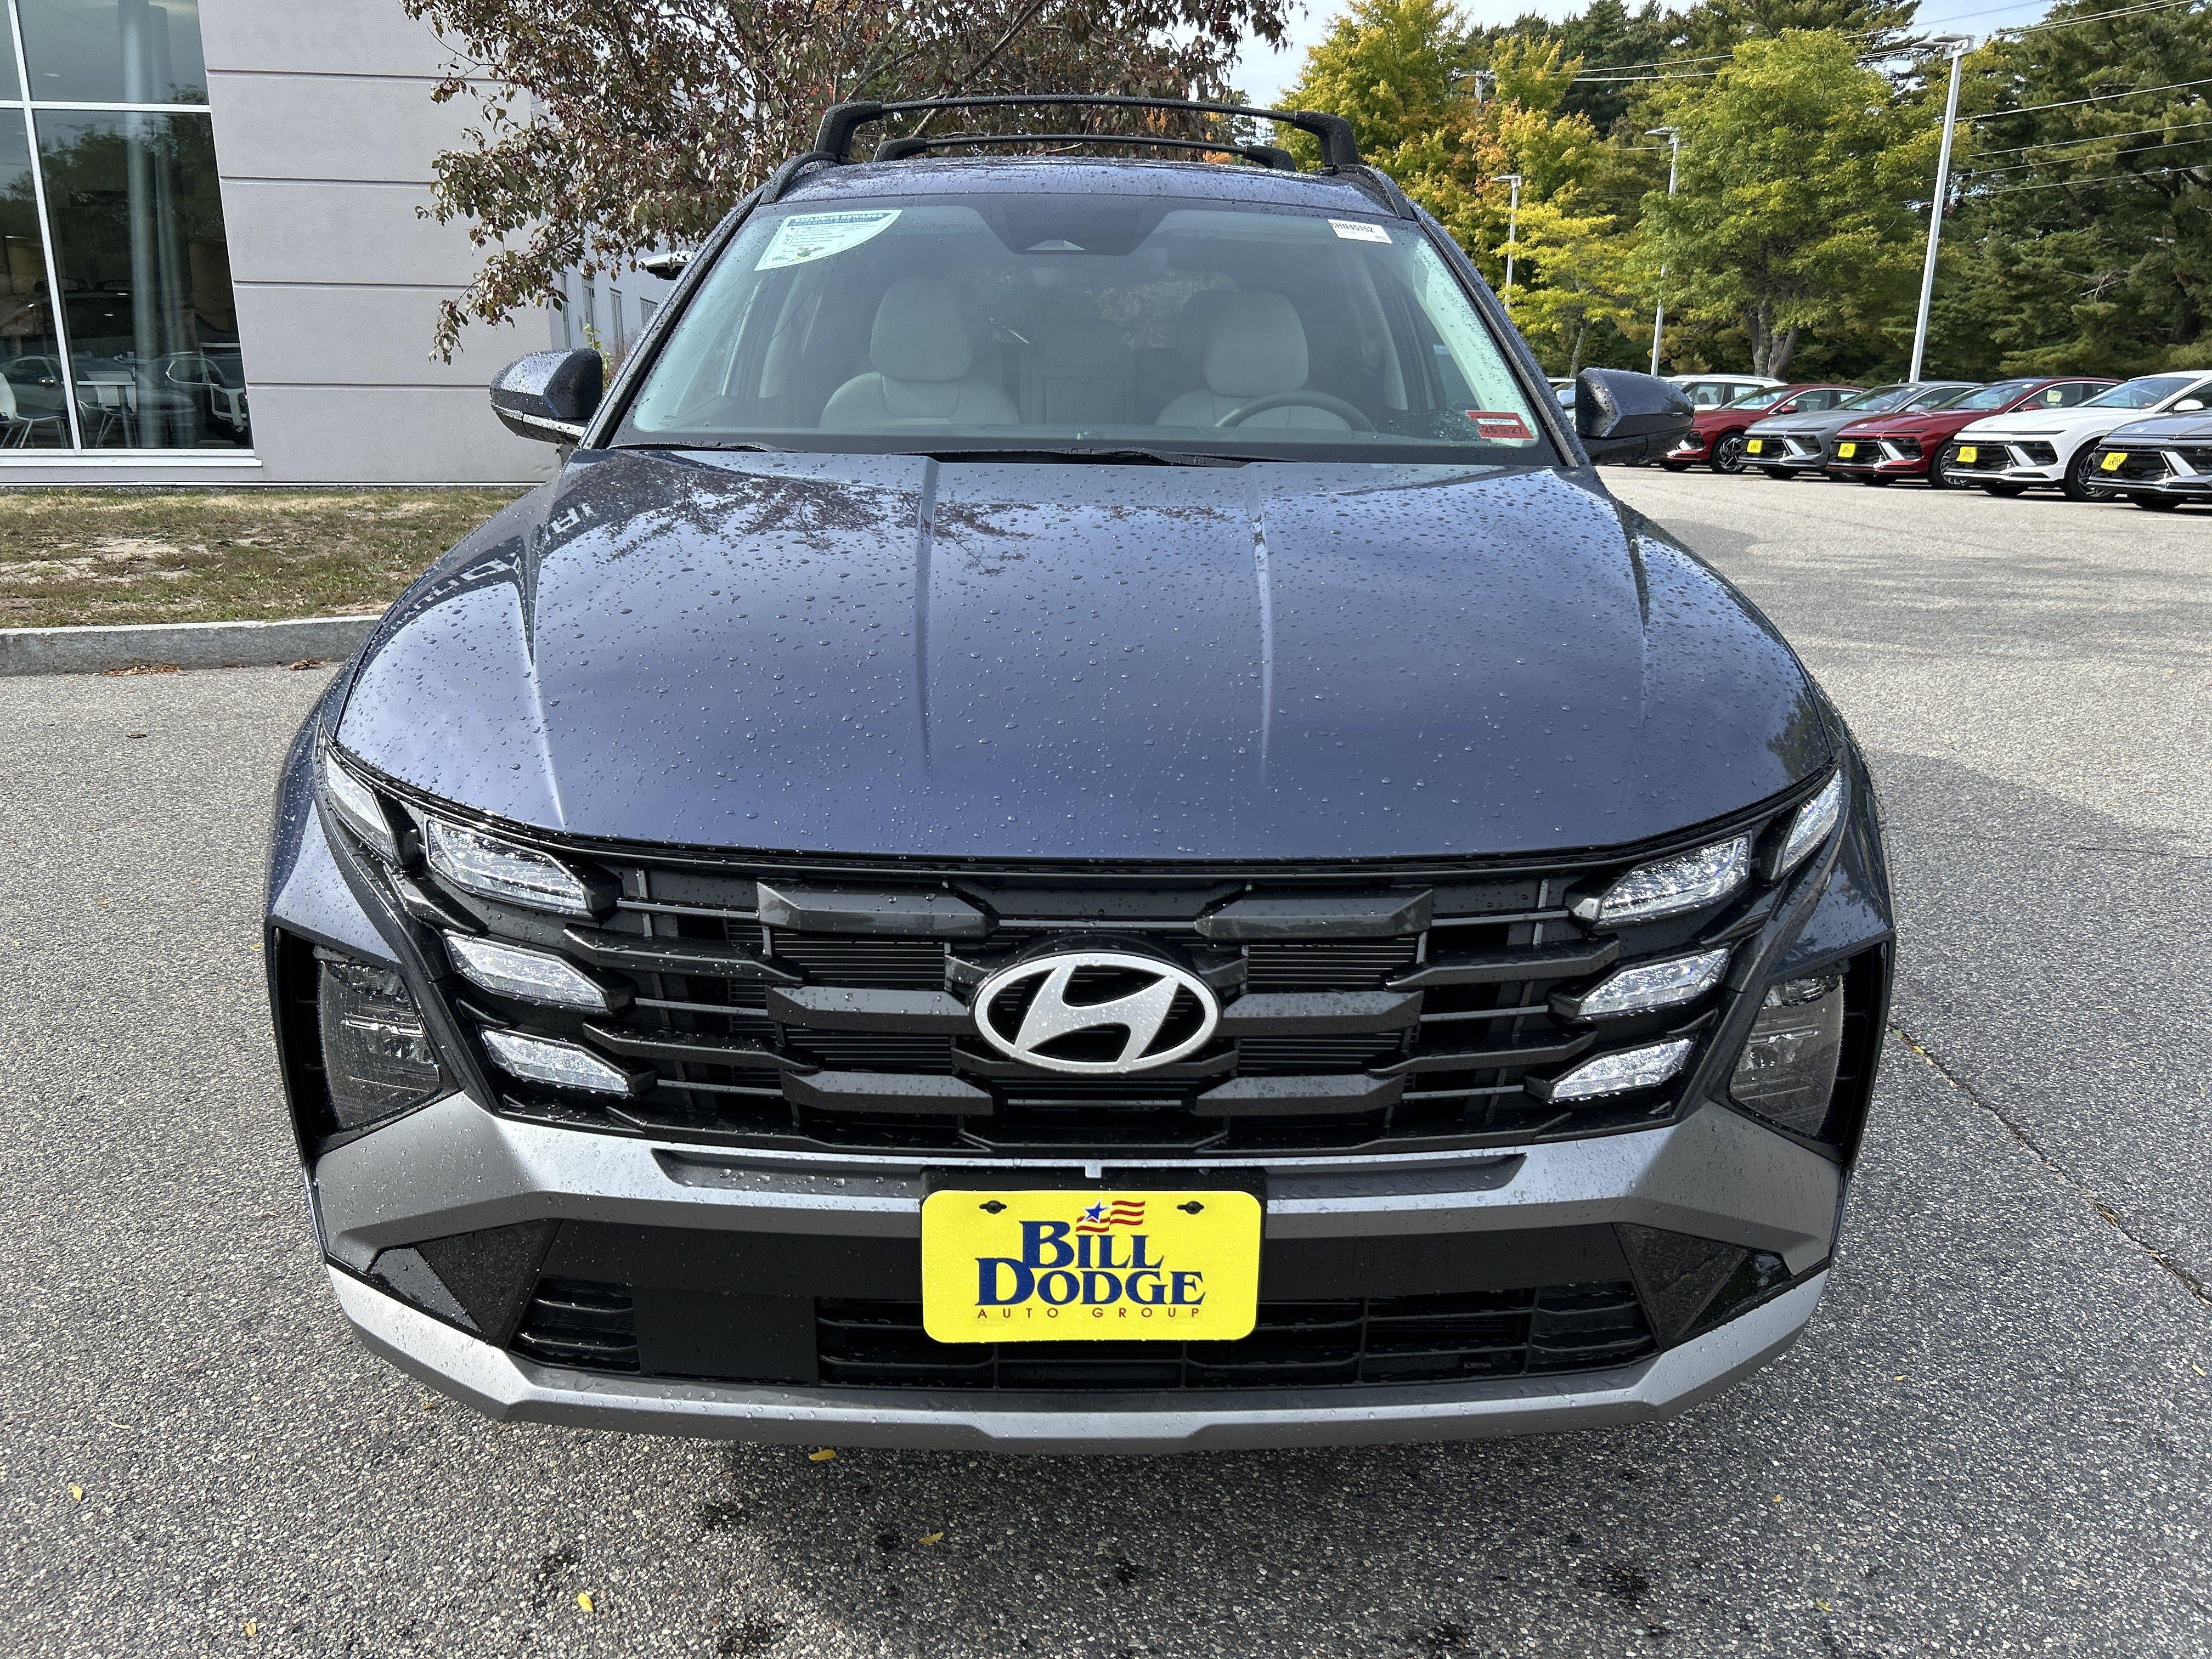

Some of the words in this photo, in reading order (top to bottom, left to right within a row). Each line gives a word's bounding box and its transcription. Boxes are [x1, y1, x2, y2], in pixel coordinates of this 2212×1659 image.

[1019, 1220, 1165, 1269] BILL
[974, 1257, 1206, 1307] DODGE
[977, 1307, 1059, 1319] AUTO
[1091, 1307, 1200, 1319] GROUP
